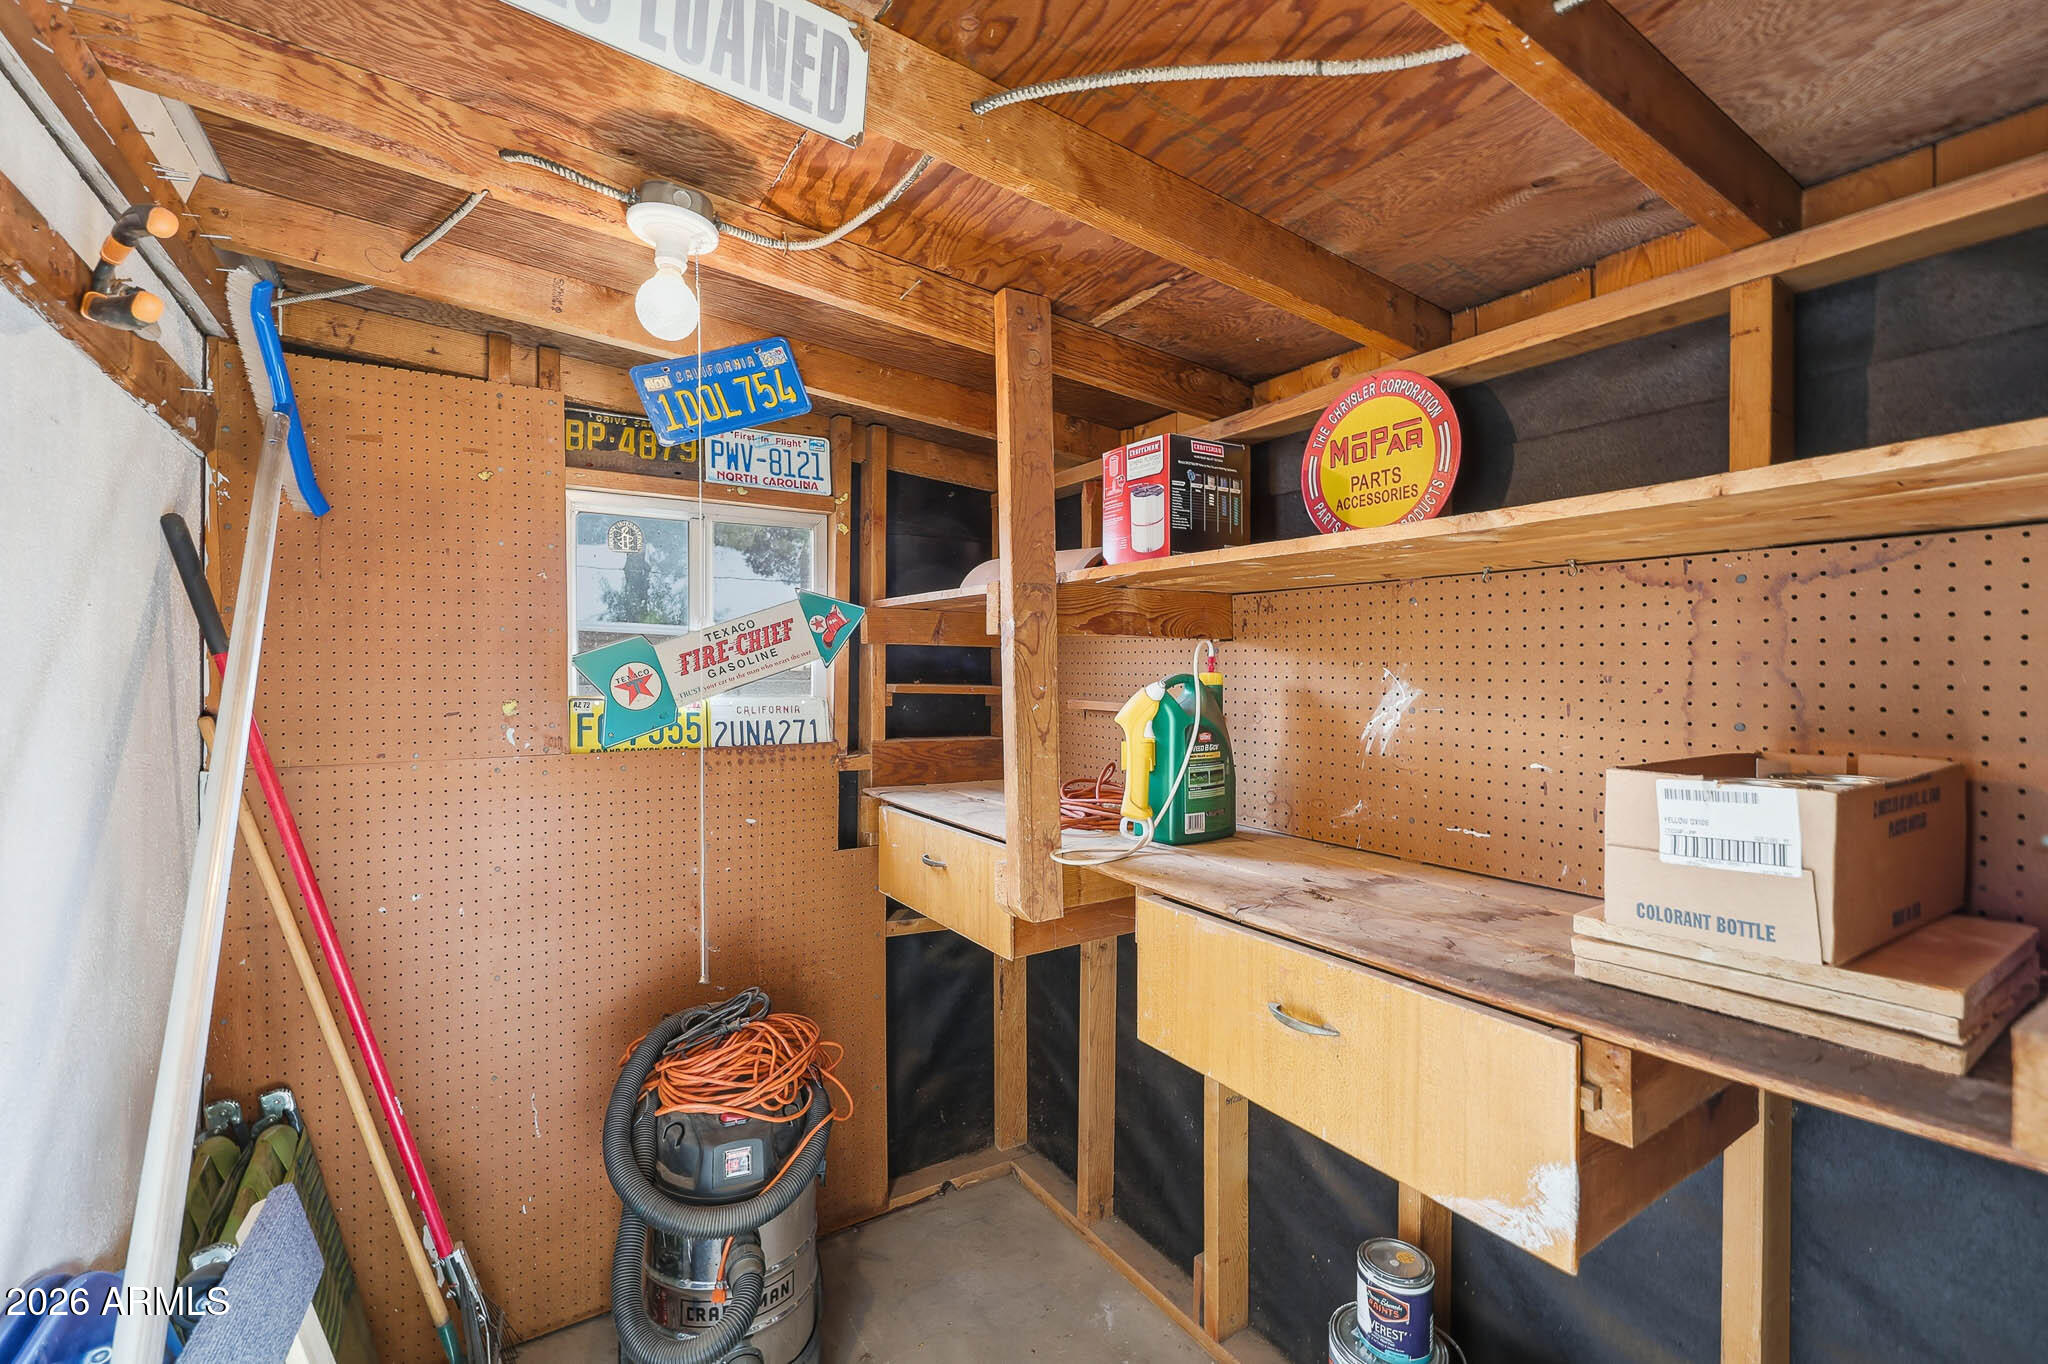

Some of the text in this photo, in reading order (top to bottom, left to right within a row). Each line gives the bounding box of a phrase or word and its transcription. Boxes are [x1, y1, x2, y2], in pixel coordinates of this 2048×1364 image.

[639, 0, 850, 125] LOANED
[674, 356, 756, 383] CALIFORNIA
[596, 415, 627, 426] DRIVE
[1313, 378, 1443, 449] THE CHRYSLER CORPORATION
[734, 431, 755, 441] First
[775, 437, 802, 448] Flight
[711, 439, 825, 481] PWV-8121
[716, 470, 819, 491] NORTH CAROLINA
[1351, 466, 1402, 493] PARTS
[1313, 478, 1445, 534] PARTS ODUCTS
[1336, 483, 1419, 512] ACCESSORIES
[704, 618, 756, 642] TEXACO
[677, 618, 794, 677] FIRE-CHIEF
[707, 647, 779, 679] GASOLINE
[679, 687, 701, 699] TRUST
[703, 682, 717, 692] your
[736, 672, 746, 680] the
[736, 704, 801, 715] CALIFORNIA
[714, 718, 818, 747] 2UNA271
[1664, 817, 1688, 825] YELLOW
[1636, 902, 1777, 942] COLORANT BOTTLE
[1371, 1319, 1405, 1342] VEREST
